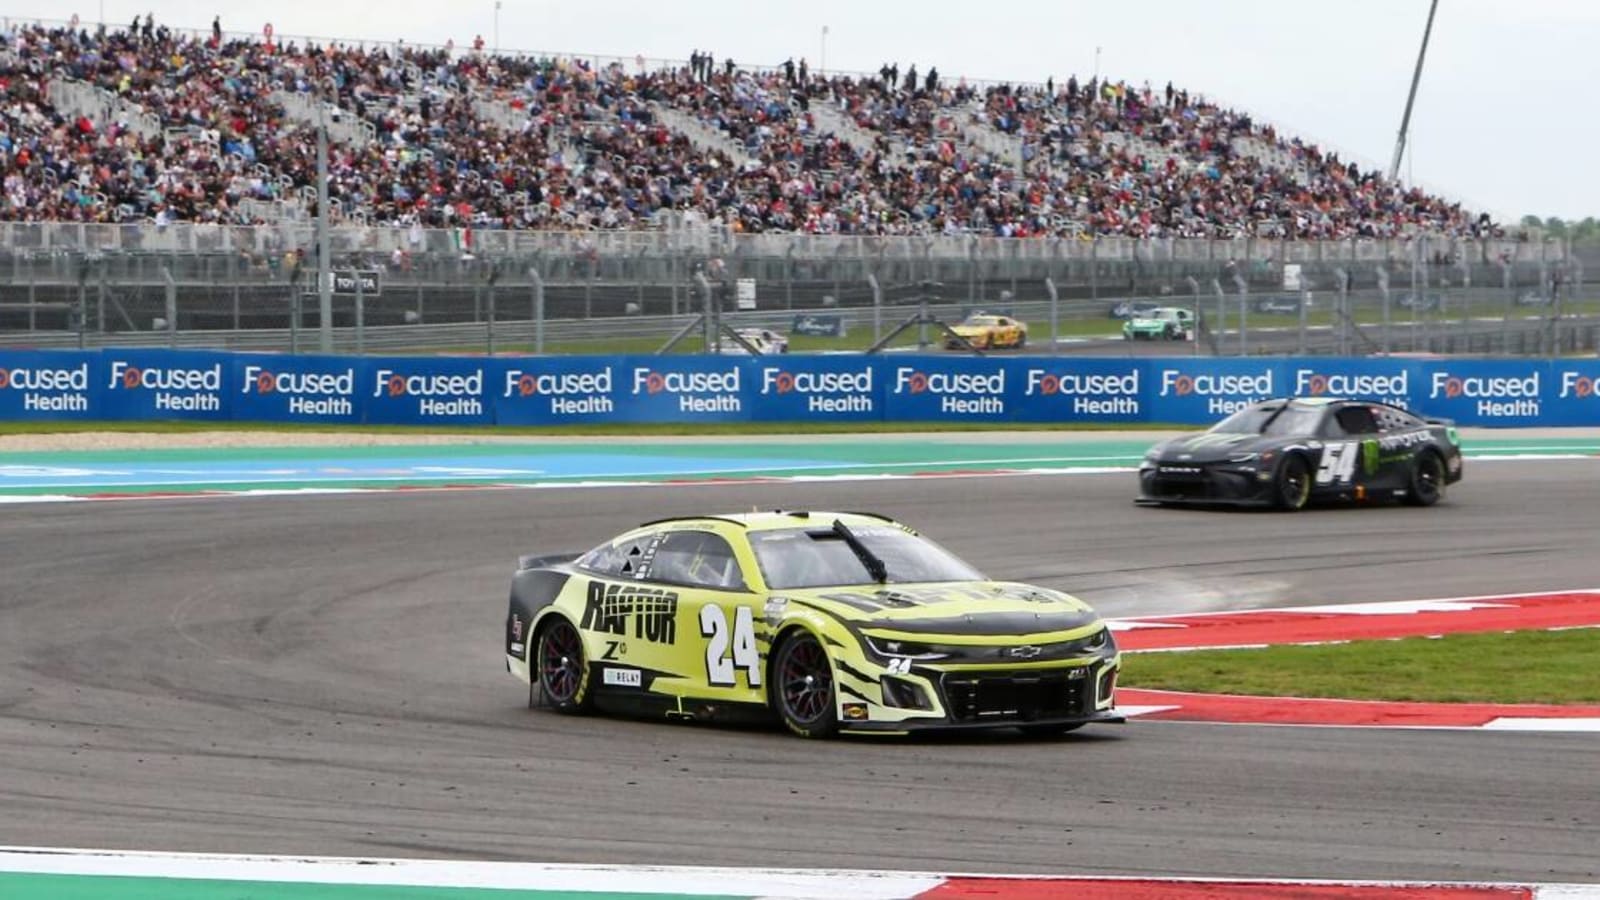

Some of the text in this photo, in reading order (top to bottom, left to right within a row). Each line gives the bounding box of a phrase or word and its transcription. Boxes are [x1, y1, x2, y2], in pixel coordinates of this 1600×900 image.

[337, 278, 375, 288] TOYTA
[110, 362, 220, 389] Focused
[243, 367, 352, 394] Focused
[375, 370, 482, 396] Focused
[505, 367, 611, 397] Focused
[633, 367, 739, 394] Focused
[762, 368, 871, 393] Focused
[895, 368, 1004, 393] Focused
[1026, 370, 1138, 394] Focused
[1161, 370, 1272, 395] Focused
[1295, 370, 1407, 395] Focused
[1431, 372, 1538, 398] Focused
[25, 394, 86, 410] Health
[157, 393, 219, 409] Health
[290, 398, 351, 414] Health
[421, 399, 481, 414] Health
[552, 396, 612, 413] Health
[680, 395, 740, 411] Health
[810, 395, 871, 411] Health
[943, 397, 1002, 412] Health
[1075, 398, 1137, 413] Health
[1209, 397, 1266, 415] Hea
[1478, 400, 1538, 416] Health
[1315, 442, 1360, 484] 54
[580, 581, 679, 645] RAPTOR
[699, 603, 762, 688] 24
[616, 671, 639, 683] RELAY
[887, 658, 912, 675] 24
